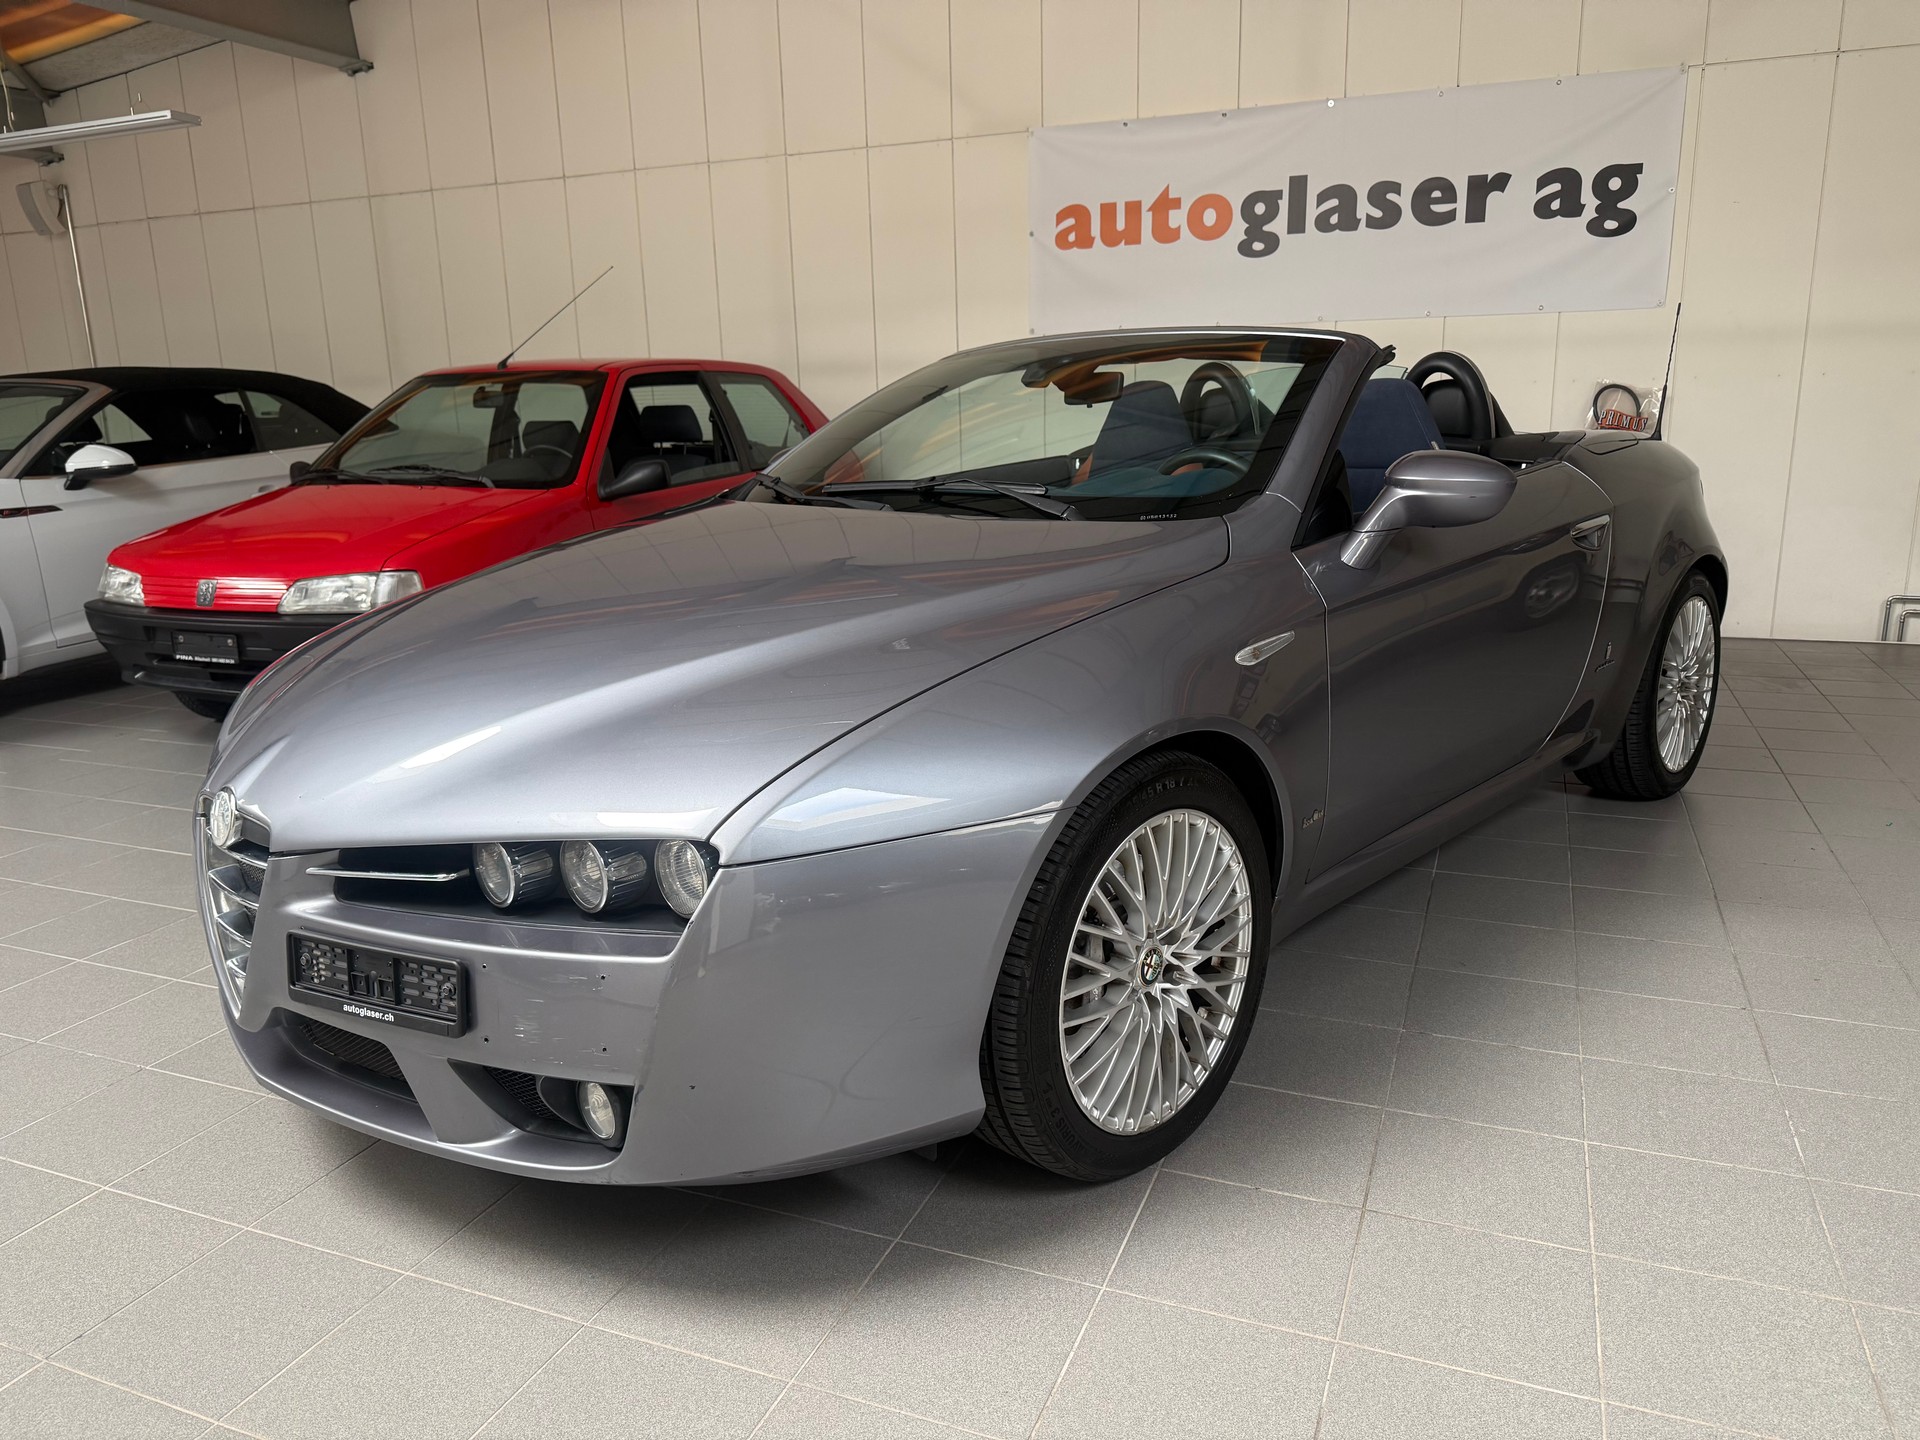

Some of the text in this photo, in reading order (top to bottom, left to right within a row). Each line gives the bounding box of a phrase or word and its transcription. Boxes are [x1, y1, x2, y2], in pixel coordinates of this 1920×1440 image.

[1054, 162, 1644, 258] autoglaser ag
[1598, 410, 1649, 431] PRIMUS
[343, 1003, 394, 1022] autoglaser.ch
